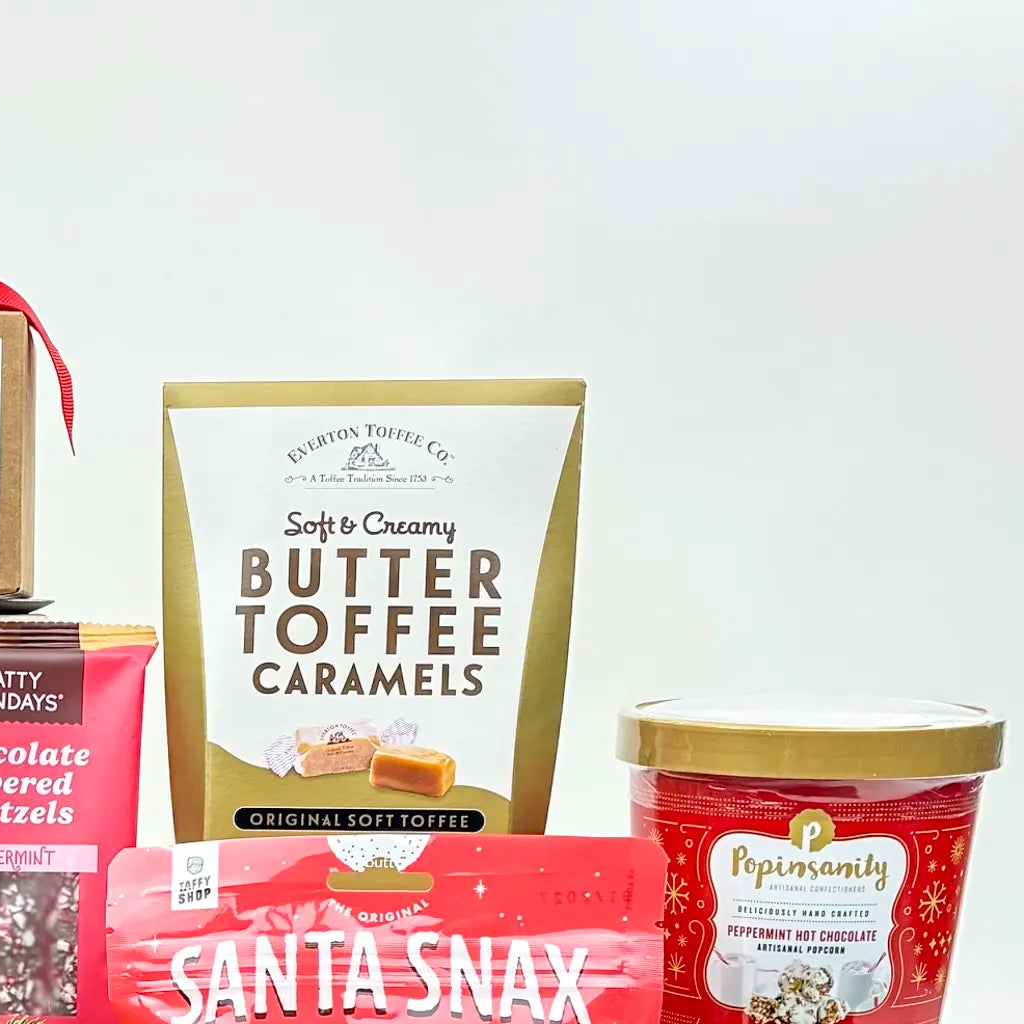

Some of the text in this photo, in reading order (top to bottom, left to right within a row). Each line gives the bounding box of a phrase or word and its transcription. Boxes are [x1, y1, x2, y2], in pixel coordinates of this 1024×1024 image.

[287, 426, 359, 463] EVERTON
[365, 424, 424, 447] TOFFEE
[319, 474, 427, 483] Toffee Tradition Since 1753
[284, 511, 456, 544] Soft & Creamy
[241, 548, 502, 599] BUTTER
[235, 604, 500, 655] TOFFEE
[252, 662, 483, 696] CARAMELS
[250, 812, 469, 828] ORIGINAL SOFT TOFFEE
[732, 845, 889, 892] Popinsanity
[179, 876, 211, 892] TAFFY
[178, 888, 211, 904] SHOP
[328, 898, 429, 923] THE ORIGINAL
[738, 905, 869, 918] DELICIOUSLY HAND CRAFTED
[728, 925, 876, 942] PEPPERMINT HOT CHOCOLATE
[757, 944, 845, 954] ARTISANAL POPCORN
